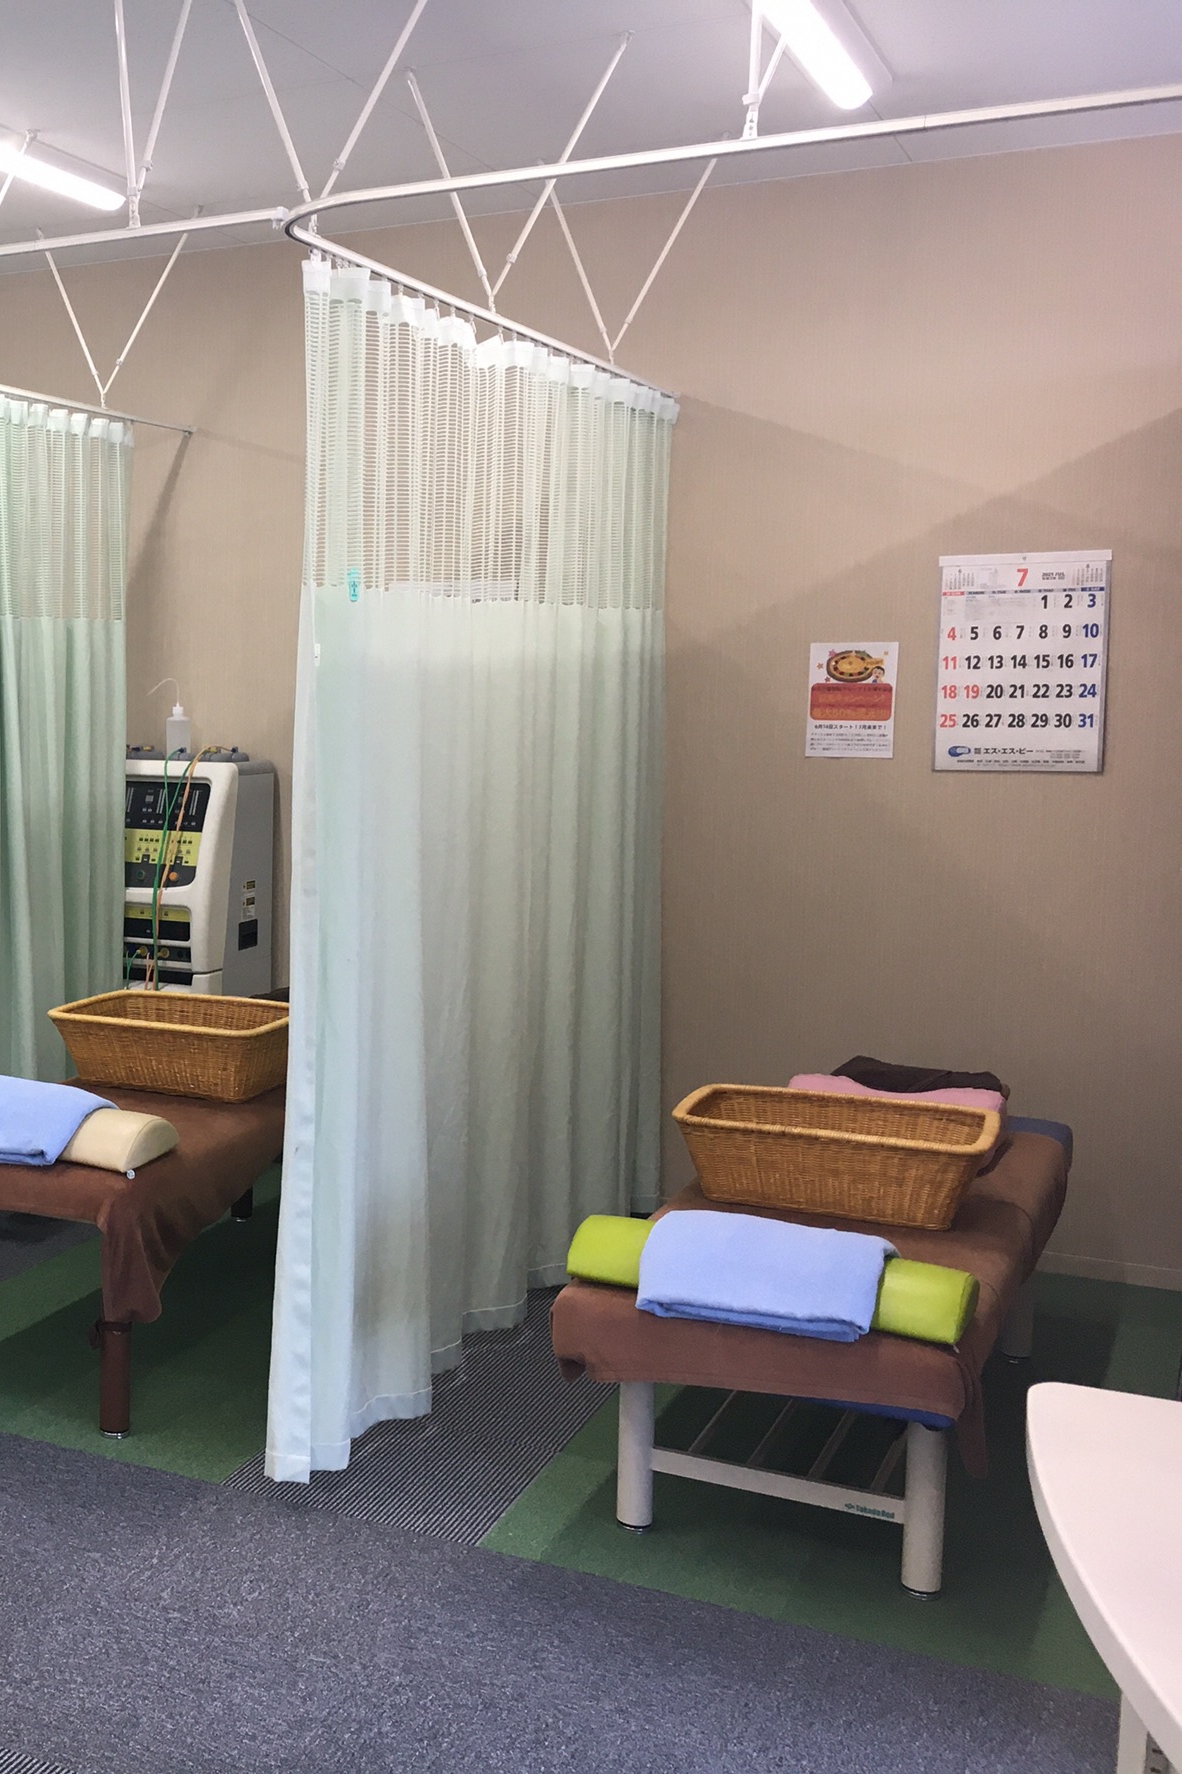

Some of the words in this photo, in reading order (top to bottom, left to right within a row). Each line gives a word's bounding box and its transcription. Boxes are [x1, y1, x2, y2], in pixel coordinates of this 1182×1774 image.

[1017, 568, 1028, 587] 7
[1040, 595, 1048, 609] 1
[1063, 594, 1073, 608] 2
[1087, 594, 1096, 608] 3
[947, 627, 957, 640] 4
[970, 627, 979, 640] 5
[992, 626, 1002, 640] 6
[1016, 625, 1024, 639] 7
[1039, 625, 1048, 639] 8
[1062, 624, 1072, 638] 9
[1082, 623, 1099, 638] 10
[942, 656, 957, 670] 11
[965, 656, 980, 669] 12
[988, 655, 1003, 669] 13
[1011, 655, 1027, 669] 14
[1034, 654, 1050, 668] 15
[1057, 654, 1074, 668] 16
[1081, 654, 1098, 668] 17
[941, 685, 957, 699] 18
[964, 685, 979, 699] 19
[986, 684, 1003, 698] 20
[1009, 684, 1025, 698] 21
[1032, 684, 1049, 698] 22
[1055, 684, 1073, 698] 23
[1079, 684, 1097, 698] 24
[940, 714, 956, 728] 25
[962, 714, 979, 728] 26
[985, 714, 1002, 728] 27
[1007, 714, 1025, 728] 28
[1031, 714, 1048, 728] 29
[1054, 714, 1072, 728] 30
[1078, 714, 1094, 728] 31
[983, 747, 1034, 755] エス・エス・ビー
